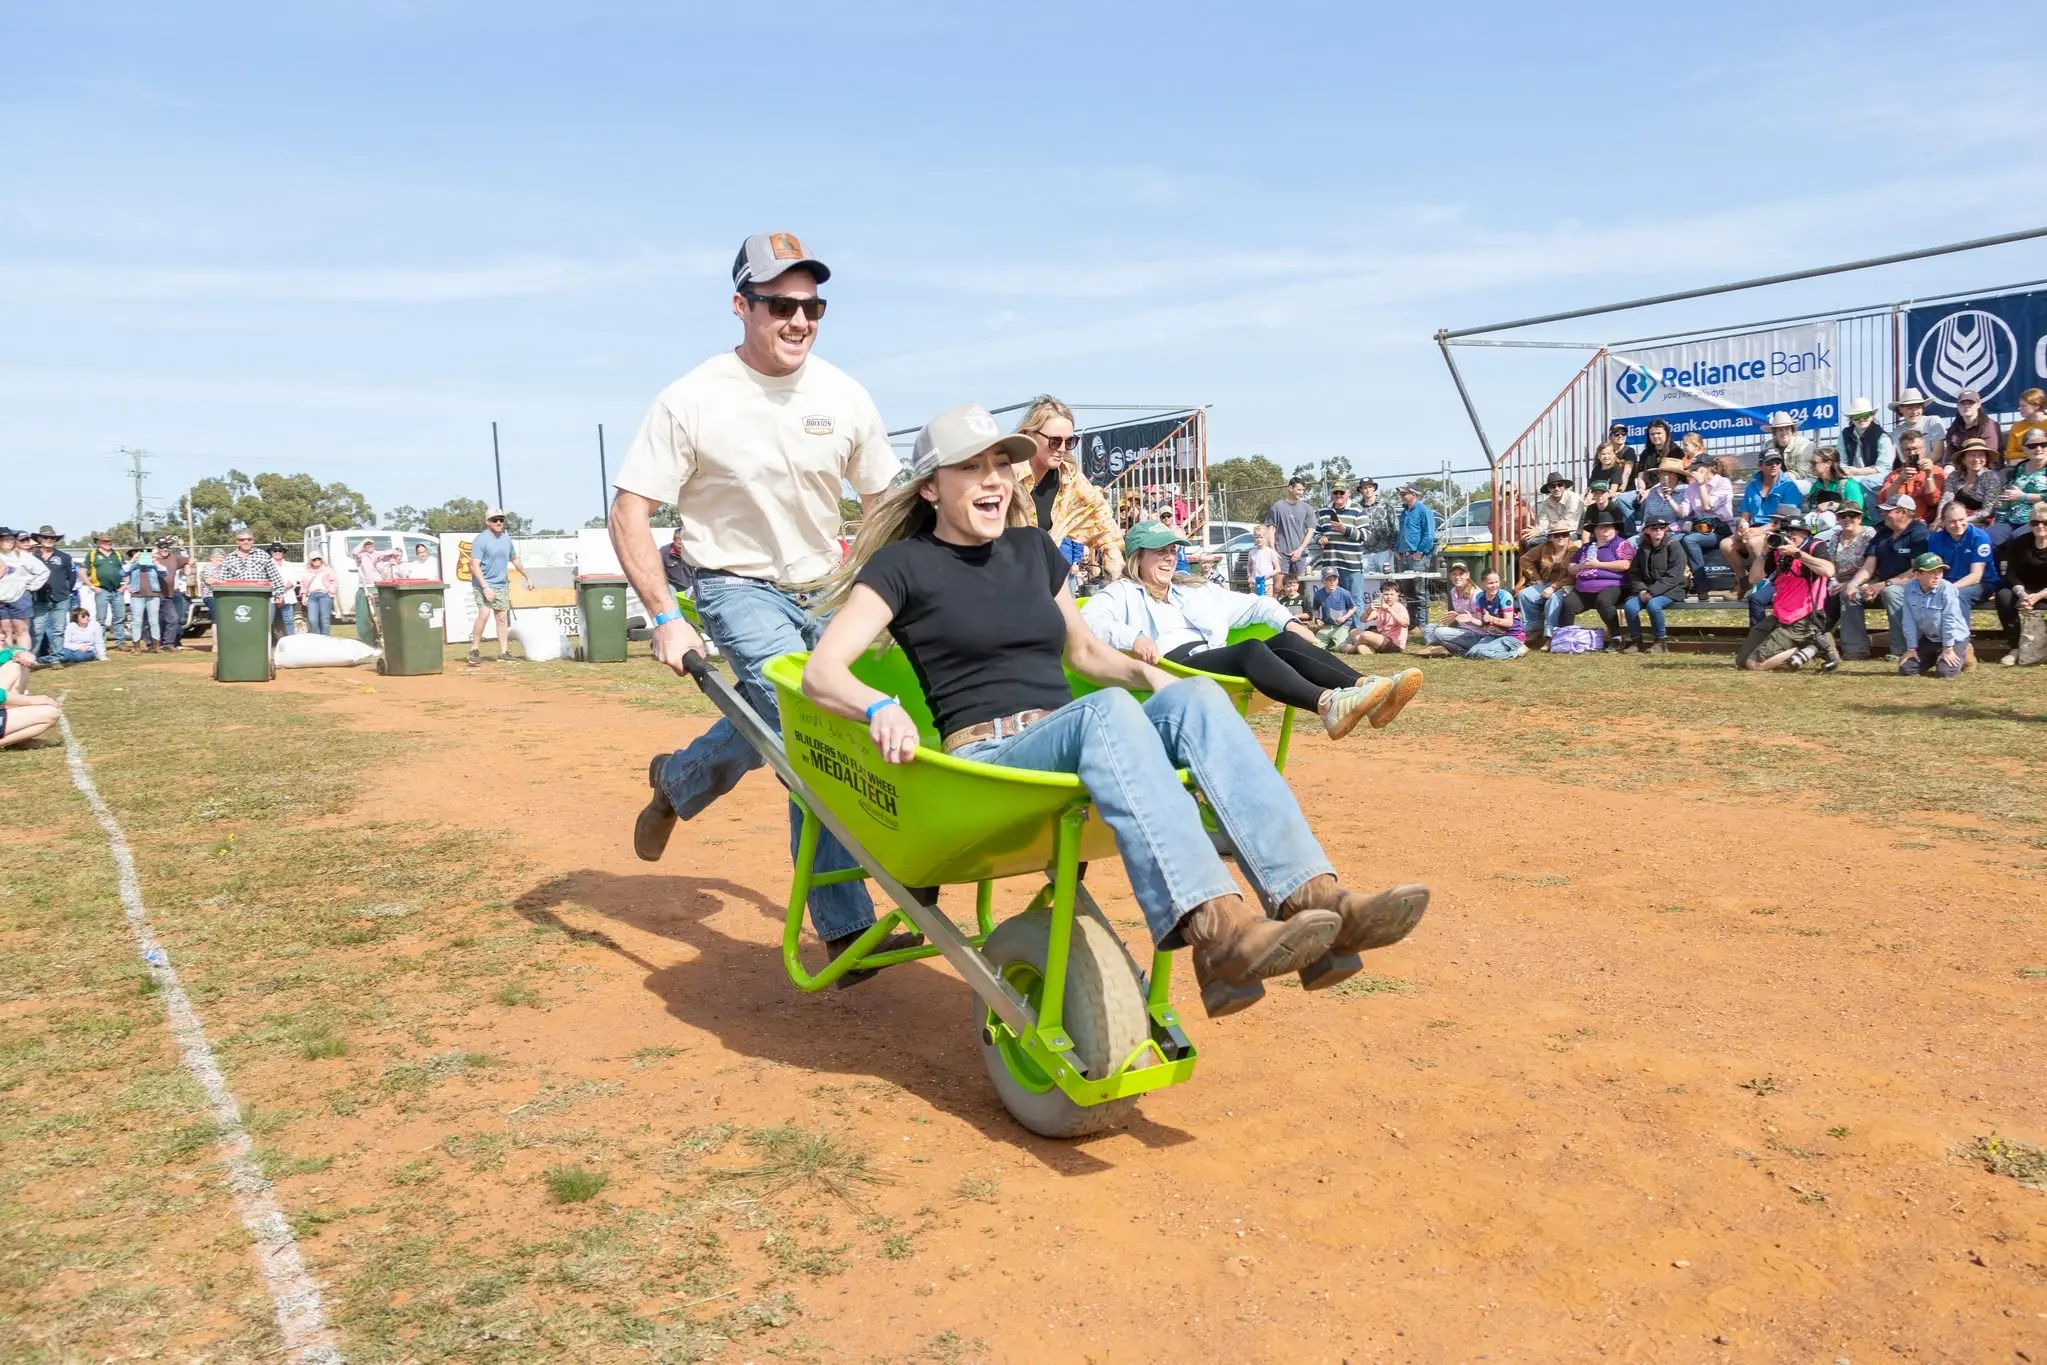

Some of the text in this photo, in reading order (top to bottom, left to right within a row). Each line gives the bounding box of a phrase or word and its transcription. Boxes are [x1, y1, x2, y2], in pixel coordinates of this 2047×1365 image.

[1661, 342, 1832, 388] Reliance Bank
[1812, 404, 1834, 420] 40
[794, 729, 836, 758] BUILDERS
[837, 748, 850, 766] NO
[867, 772, 899, 798] WHEEL
[810, 749, 898, 817] MEDALTECH
